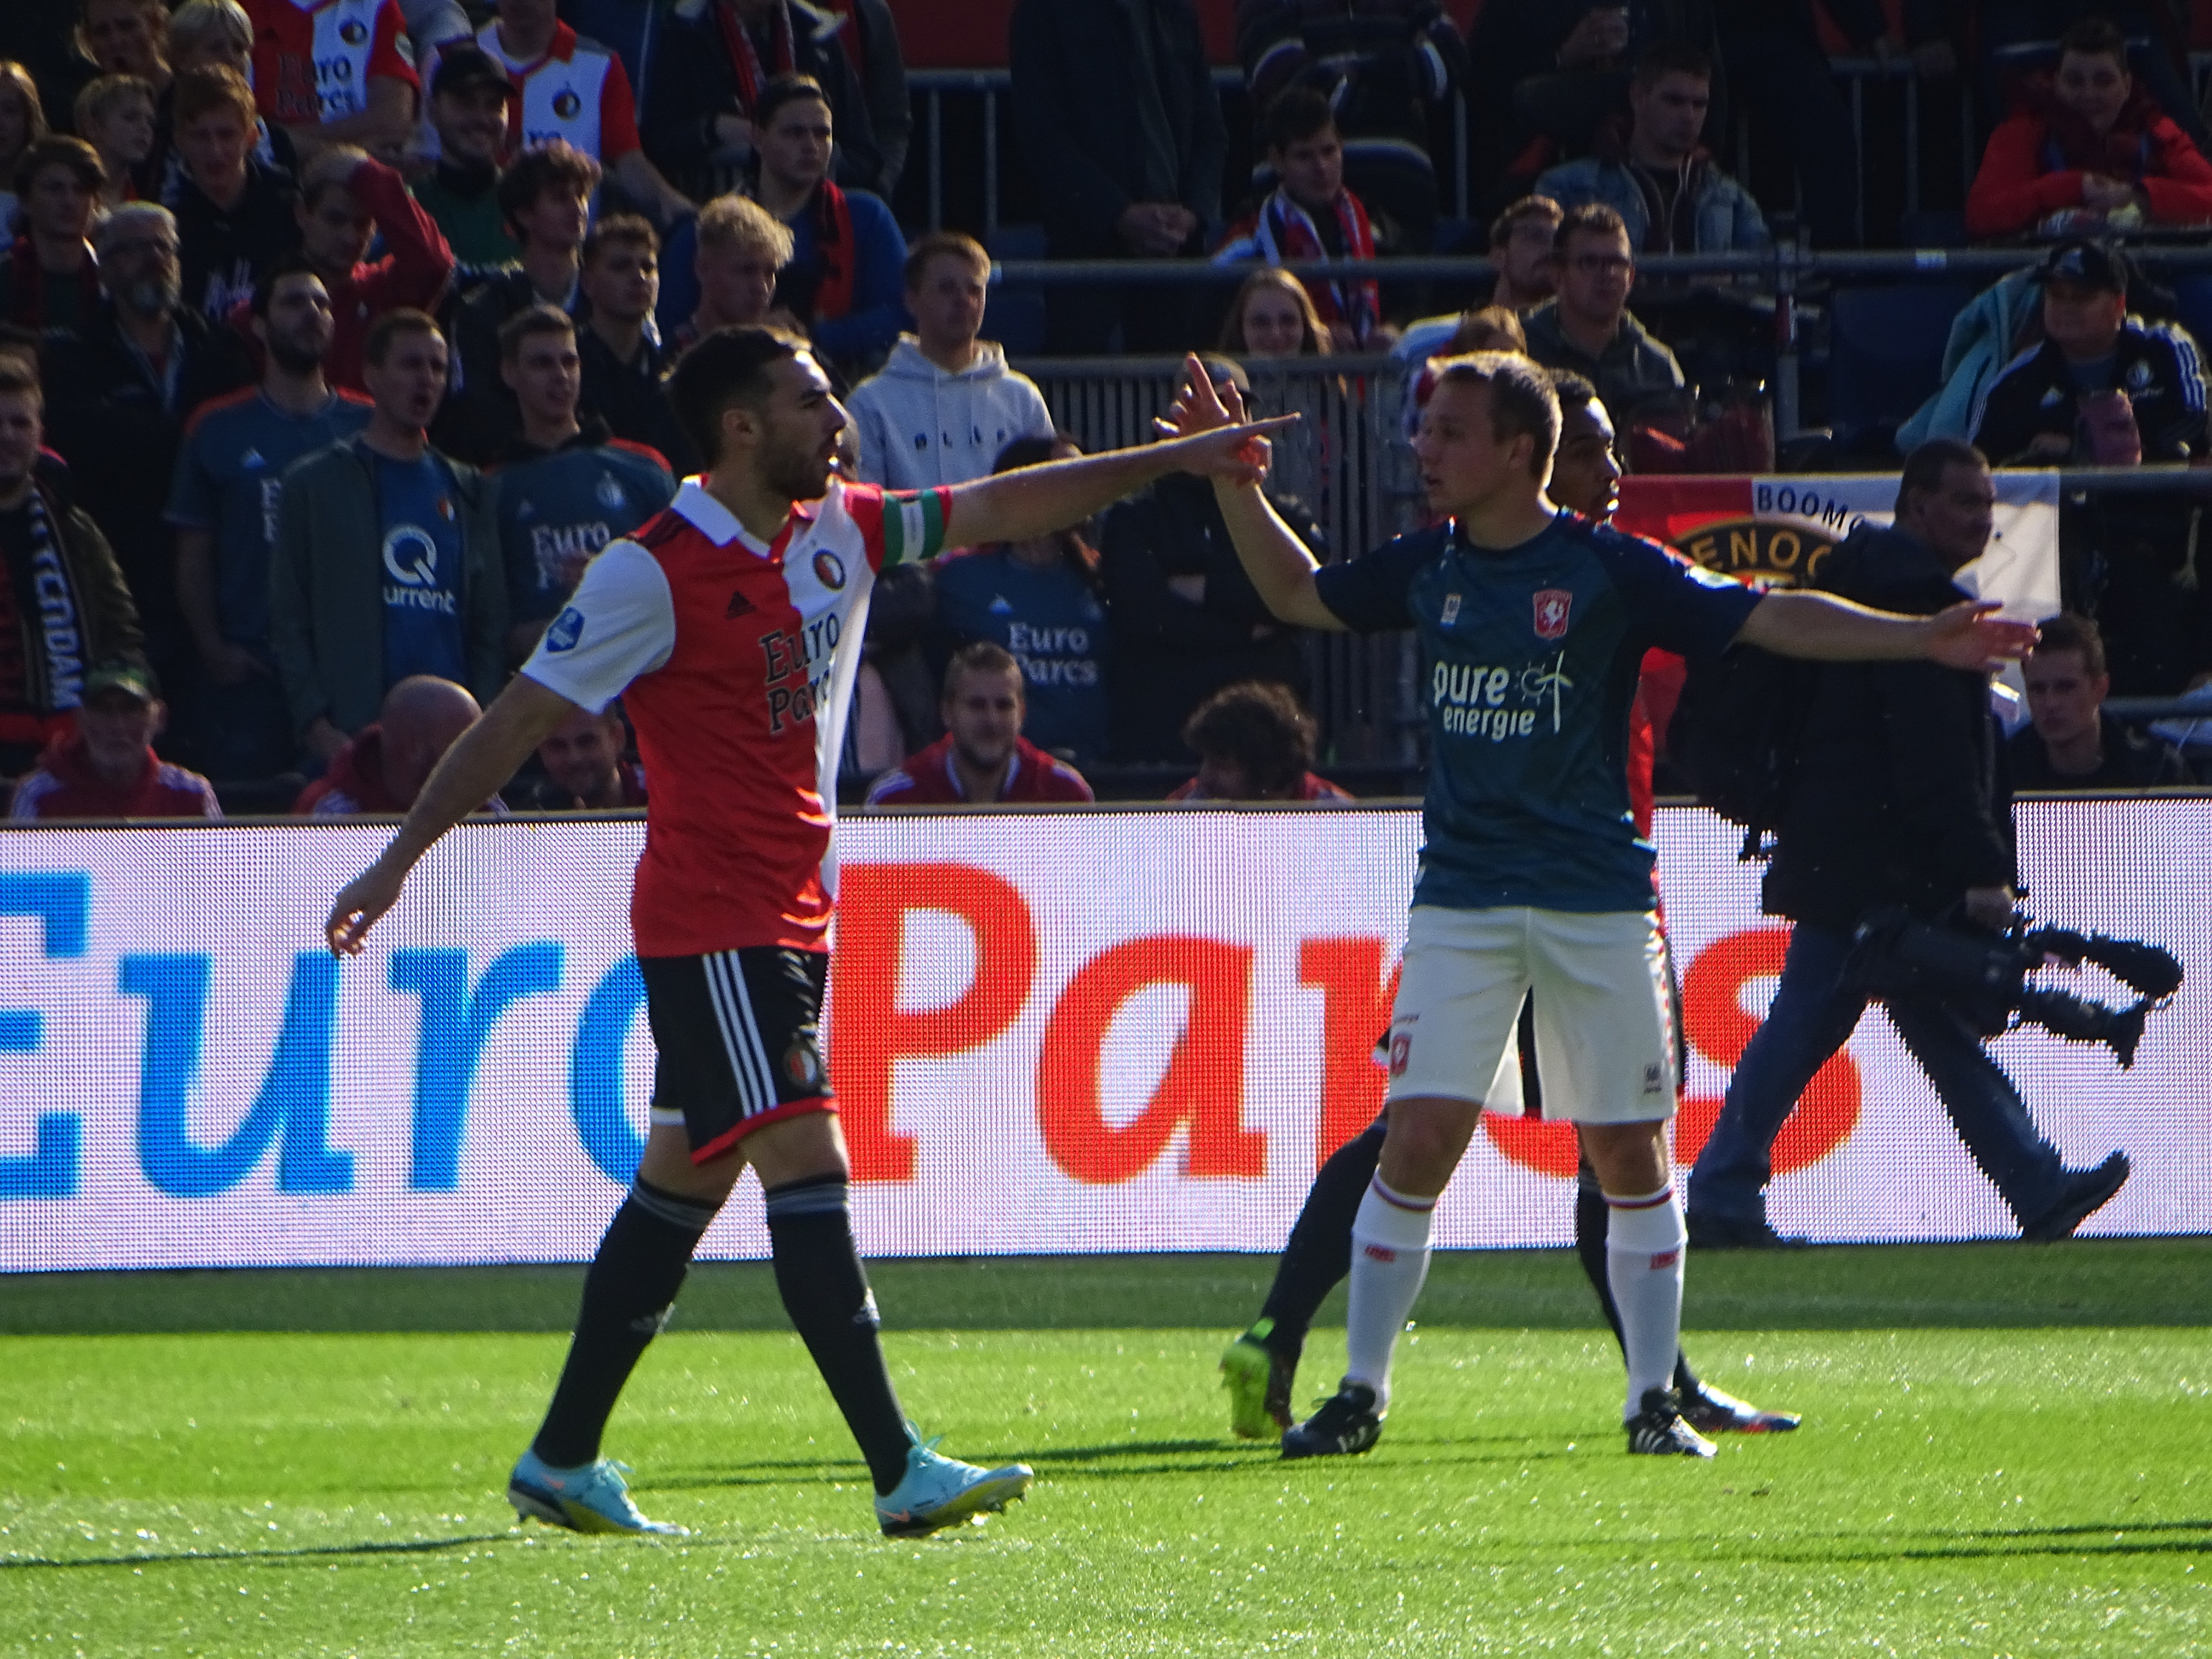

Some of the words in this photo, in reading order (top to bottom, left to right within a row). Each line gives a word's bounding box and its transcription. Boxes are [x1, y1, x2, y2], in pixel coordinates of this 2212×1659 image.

[382, 523, 438, 589] Q
[759, 612, 839, 684] Euro
[1007, 622, 1089, 654] Euro
[1433, 660, 1510, 708] pure
[1442, 704, 1536, 744] energie
